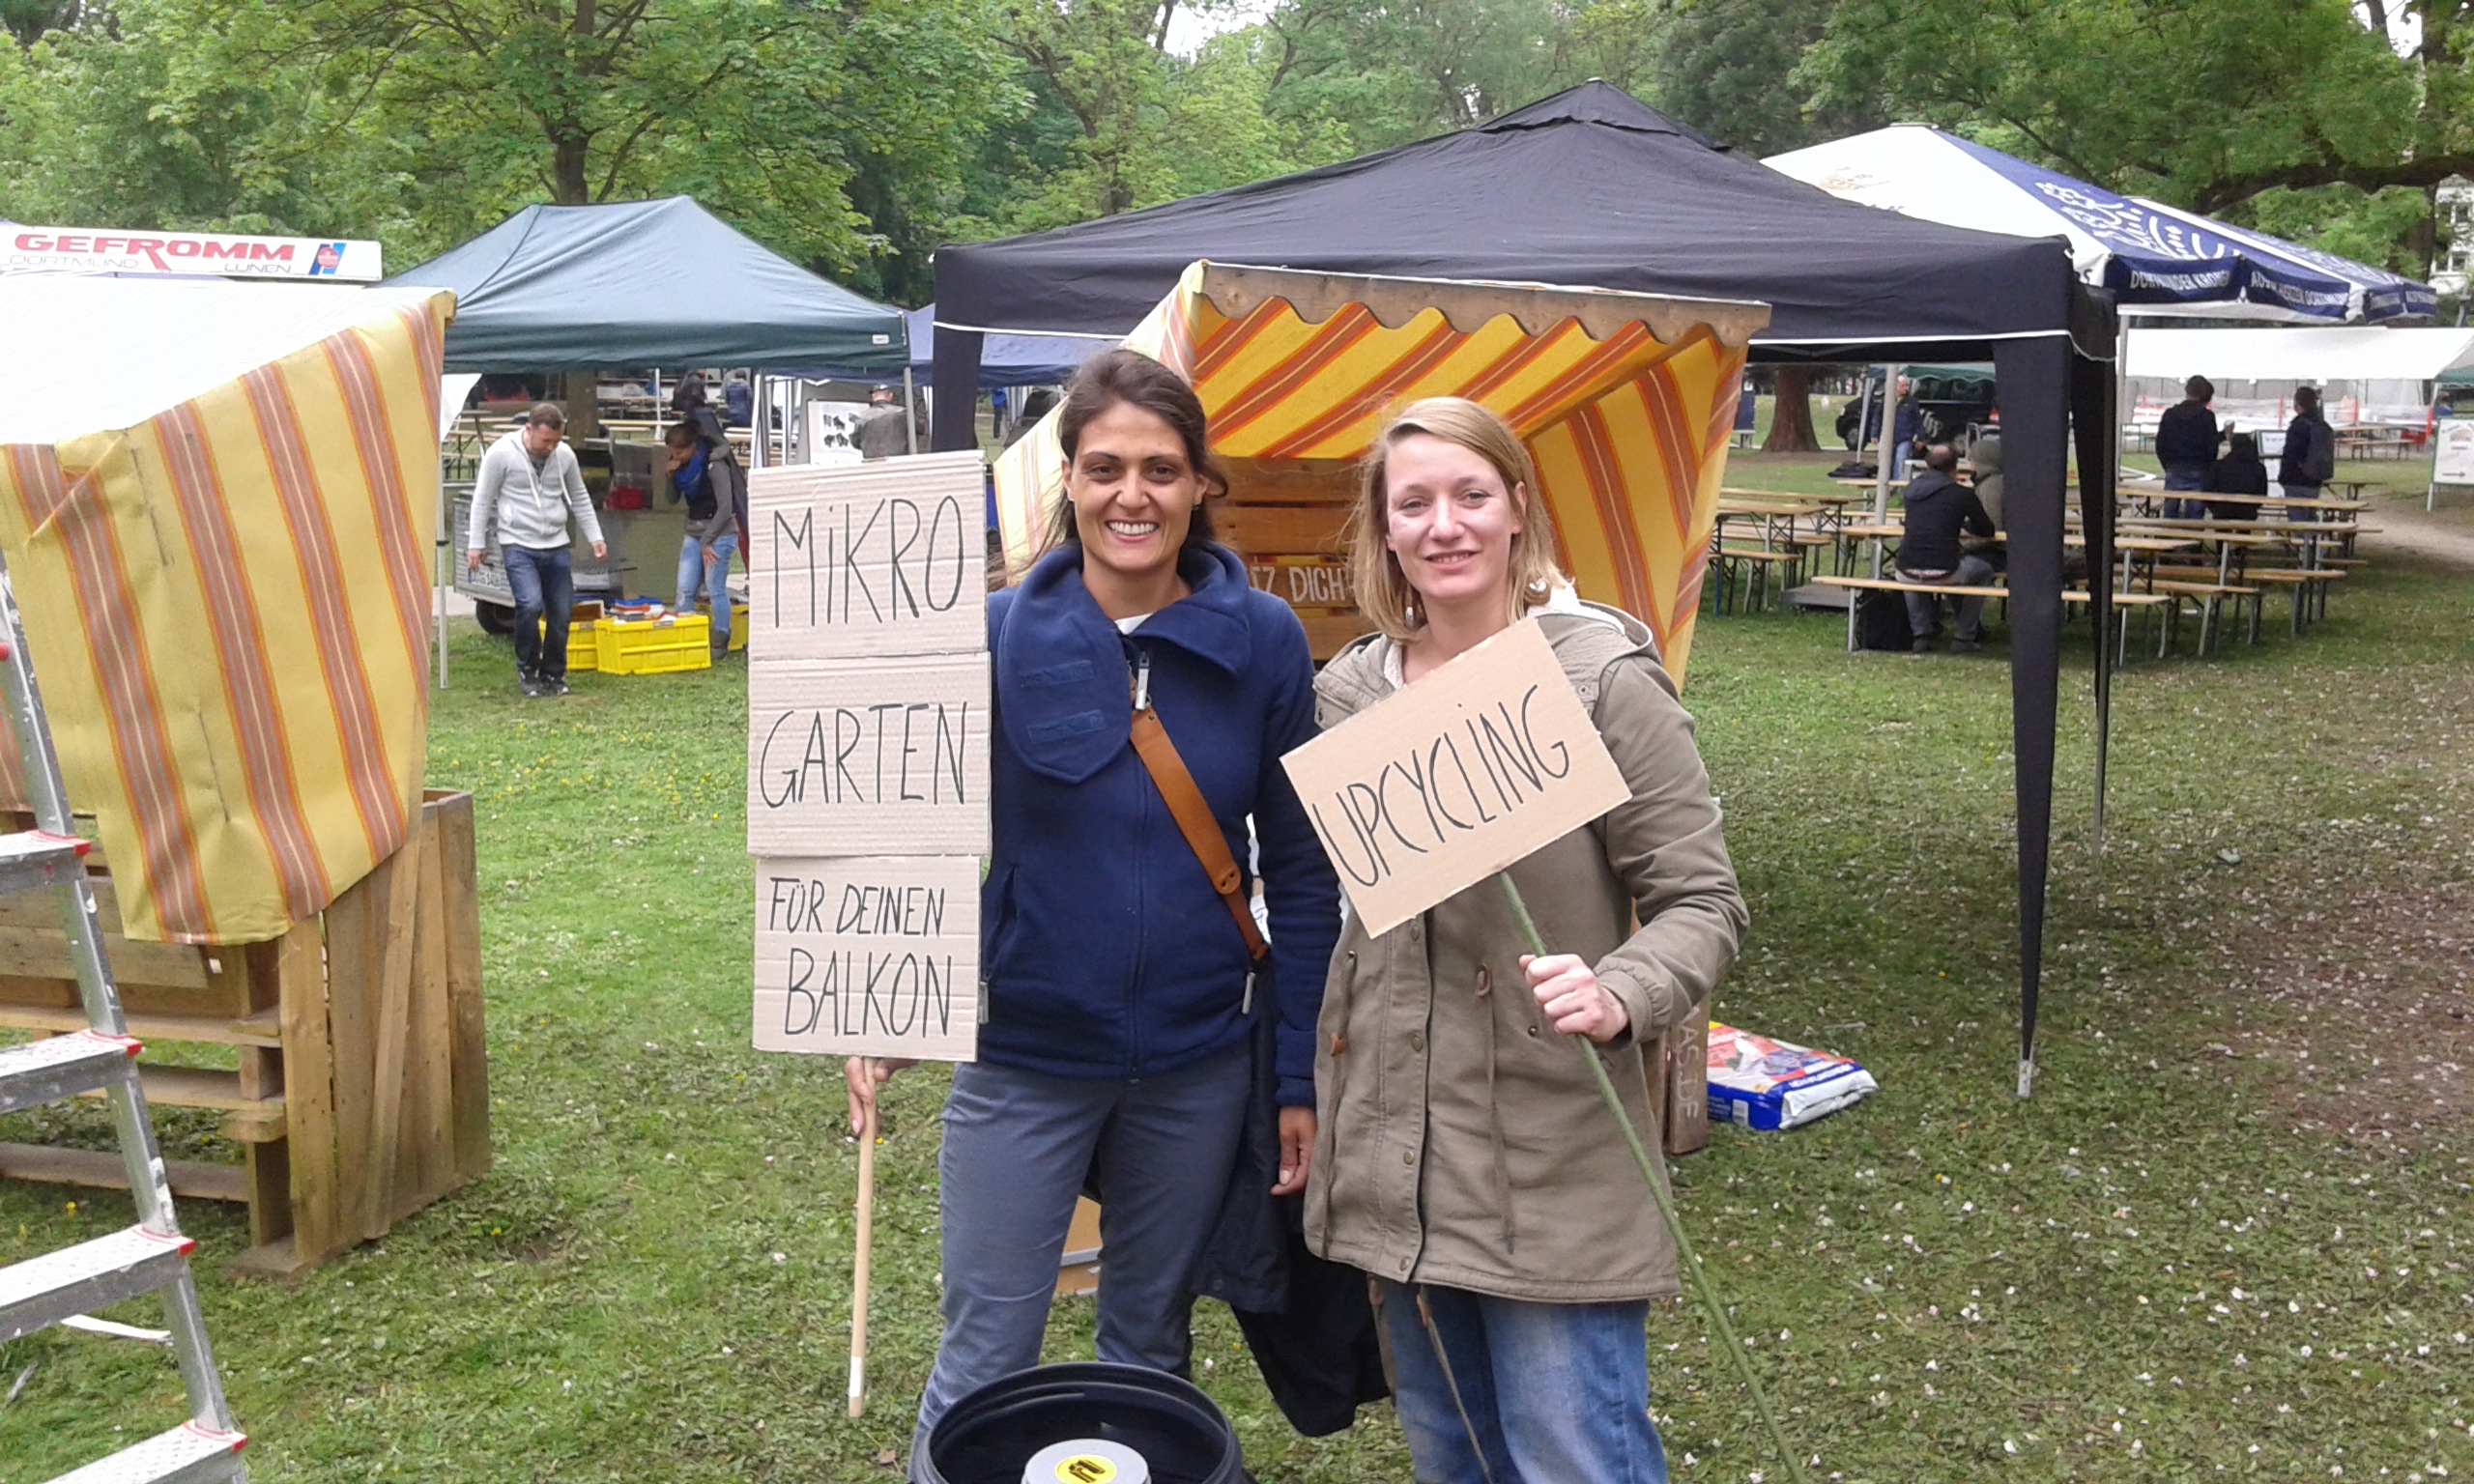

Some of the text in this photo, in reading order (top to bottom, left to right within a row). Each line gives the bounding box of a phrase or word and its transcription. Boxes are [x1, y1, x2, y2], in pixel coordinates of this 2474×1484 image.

[10, 254, 138, 269] DORTMUND
[14, 234, 295, 272] GEFROMM
[1288, 566, 1345, 603] DICH
[760, 701, 967, 809] GARTEN
[770, 876, 945, 937] FÜR DEINEN
[785, 948, 952, 1038] BALKON
